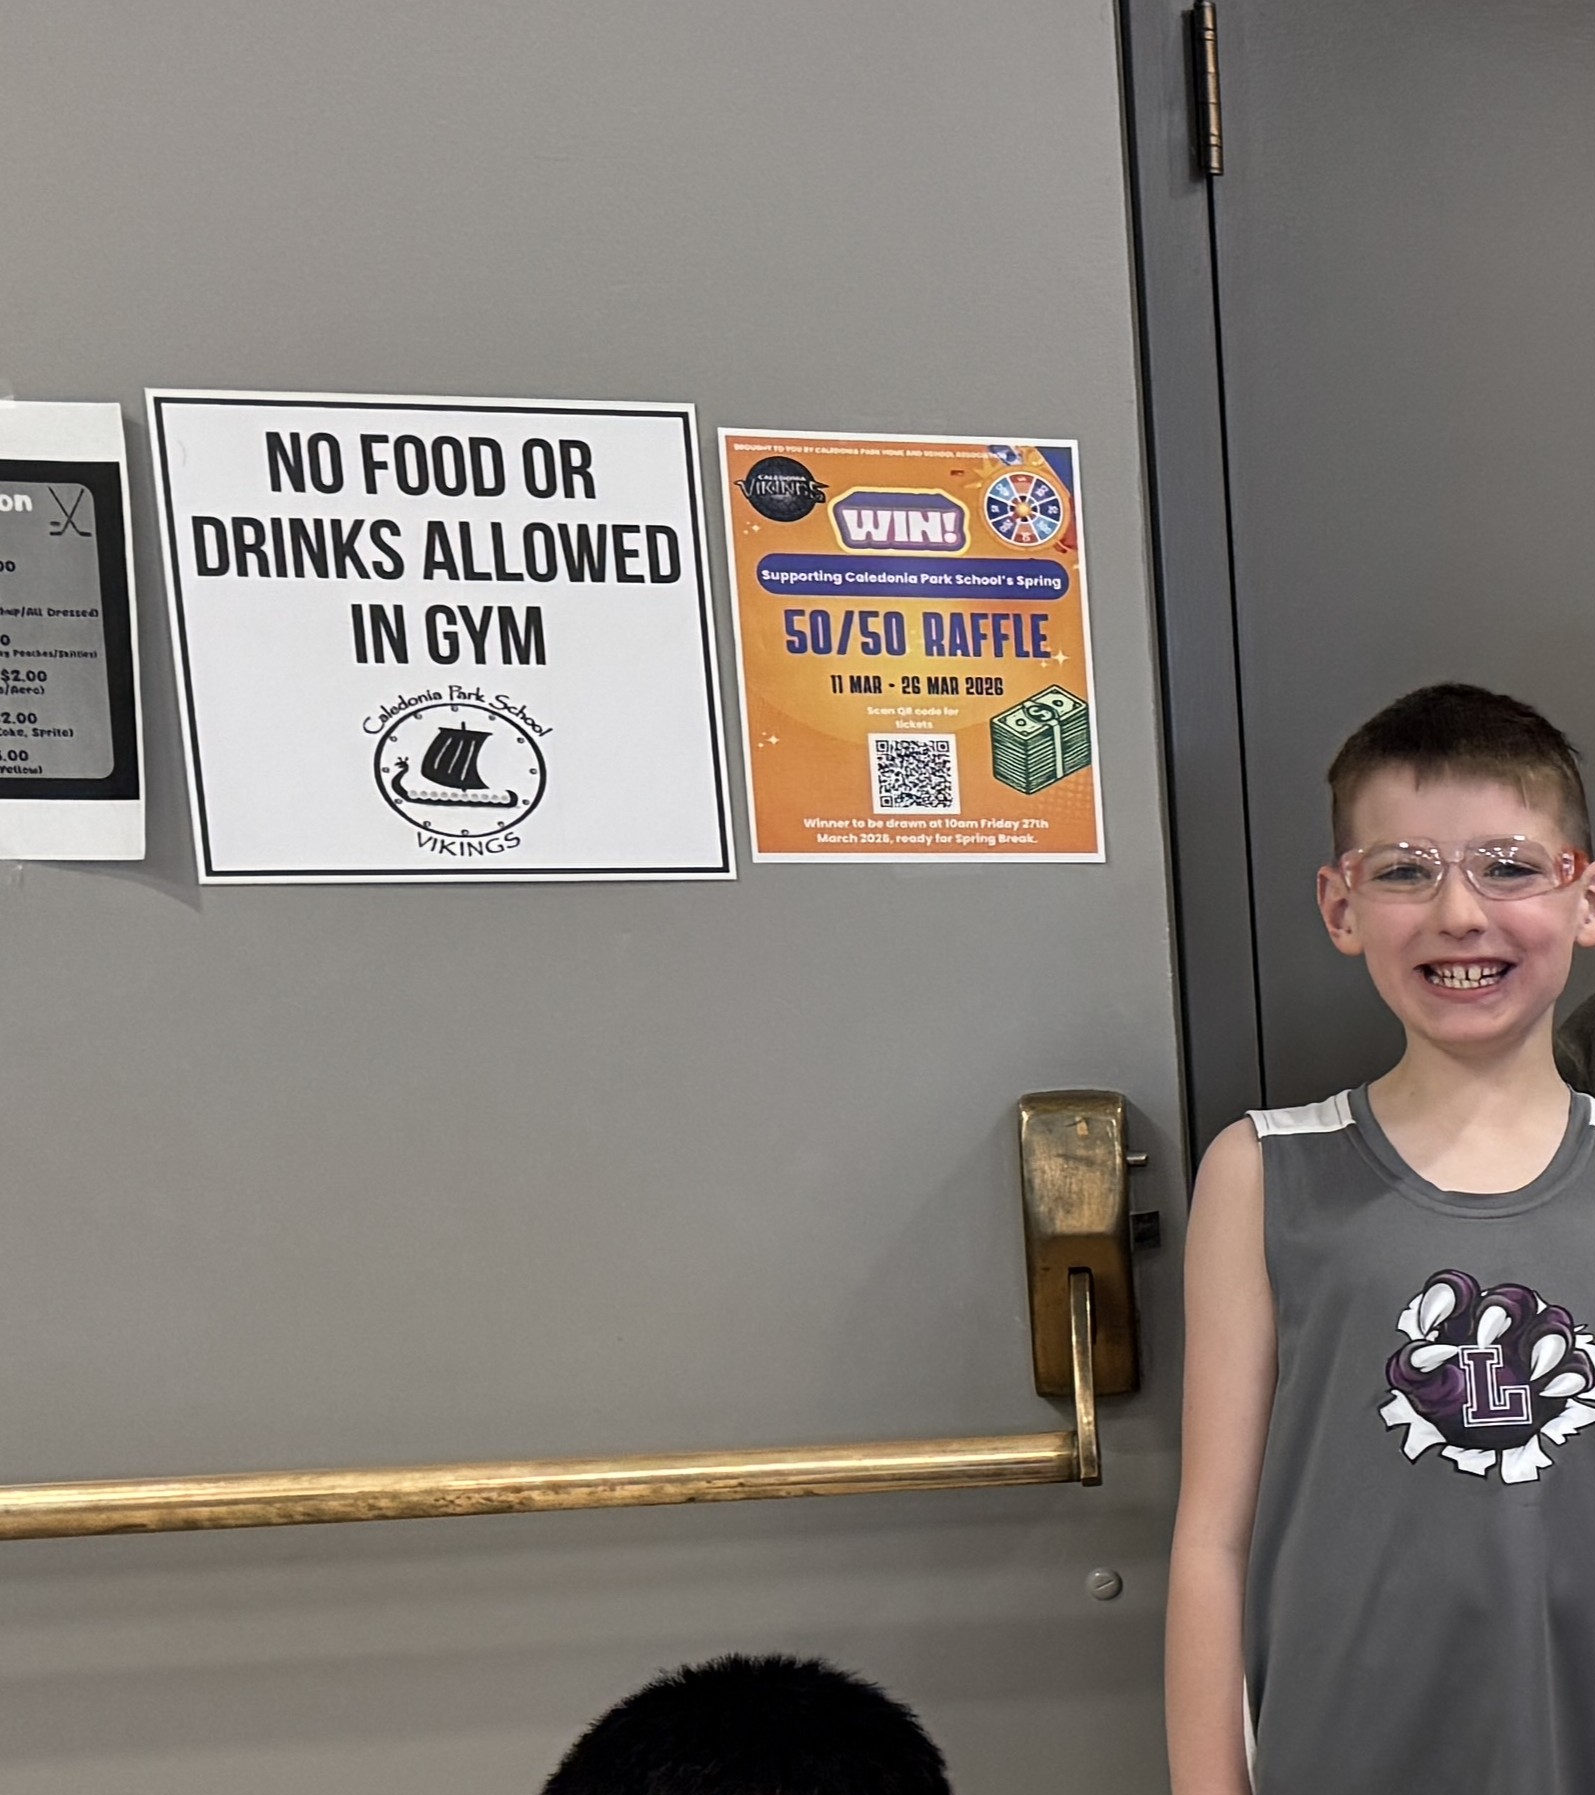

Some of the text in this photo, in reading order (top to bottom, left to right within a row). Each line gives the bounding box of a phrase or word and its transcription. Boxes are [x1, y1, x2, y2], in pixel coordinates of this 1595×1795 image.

[265, 431, 597, 500] NO FOOD OR
[841, 507, 959, 544] WIN!
[191, 515, 682, 584] DRINKS ALLOWED
[761, 569, 1062, 590] Supporting Caledonia Park School's Spring
[351, 603, 548, 666] IN GYM
[784, 608, 1051, 659] 50/50 RAFFLE
[1, 668, 48, 682] $2.00
[830, 674, 844, 694] 11
[849, 675, 883, 695] MAR
[901, 675, 921, 695] 26
[927, 676, 960, 695] MAR
[965, 676, 1004, 696] 2026
[362, 685, 554, 737] Caledonia Park School
[803, 817, 850, 829] Winner
[852, 818, 864, 829] to
[867, 818, 884, 829] be
[886, 818, 927, 829] drawn
[929, 818, 943, 829] at
[944, 818, 979, 830] 10am
[980, 818, 1020, 832] Friday
[816, 832, 859, 844] March
[896, 833, 933, 846] ready
[934, 833, 953, 844] for
[955, 833, 996, 846] Spring
[998, 833, 1038, 845] Break.
[416, 831, 521, 857] VIKINGS
[1457, 1344, 1532, 1428] L
